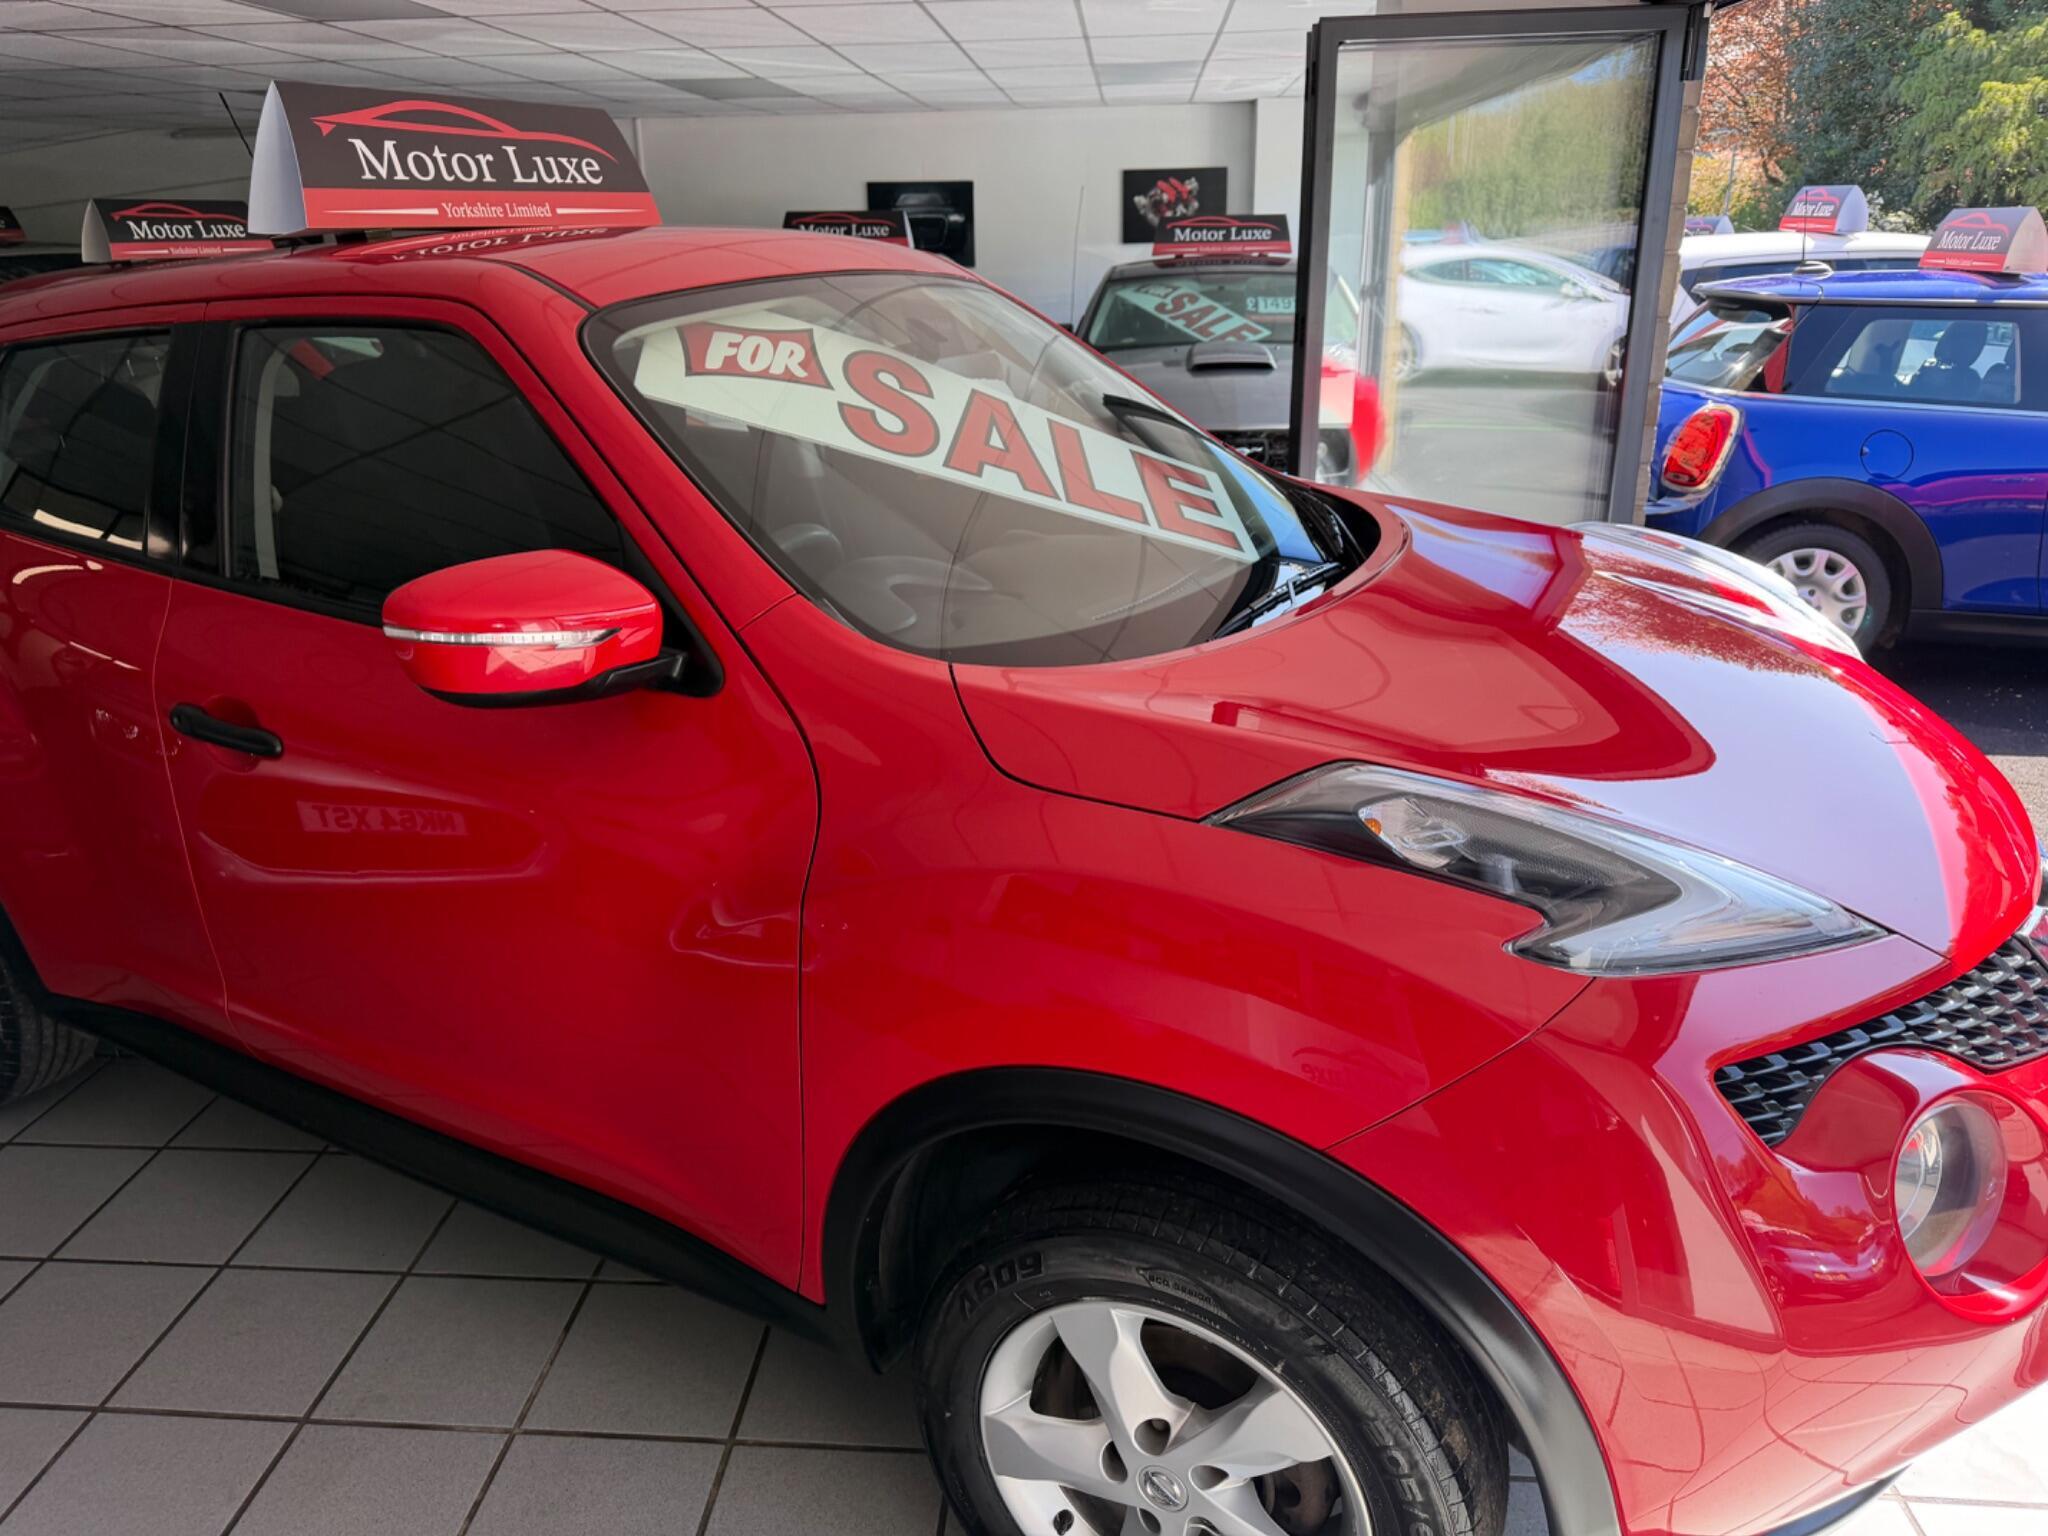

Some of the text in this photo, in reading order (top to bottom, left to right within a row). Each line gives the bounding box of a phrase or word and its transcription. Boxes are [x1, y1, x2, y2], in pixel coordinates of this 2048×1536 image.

[347, 138, 604, 185] Motor Luxe
[441, 202, 553, 218] Yorkshire Limited
[126, 219, 247, 240] Motor Luxe
[851, 223, 890, 237] Luxe
[1173, 226, 1273, 242] Motor Luxe
[1936, 230, 2002, 250] Motor Luxe
[1154, 292, 1262, 342] SALE
[703, 331, 1245, 552] FOR SALE
